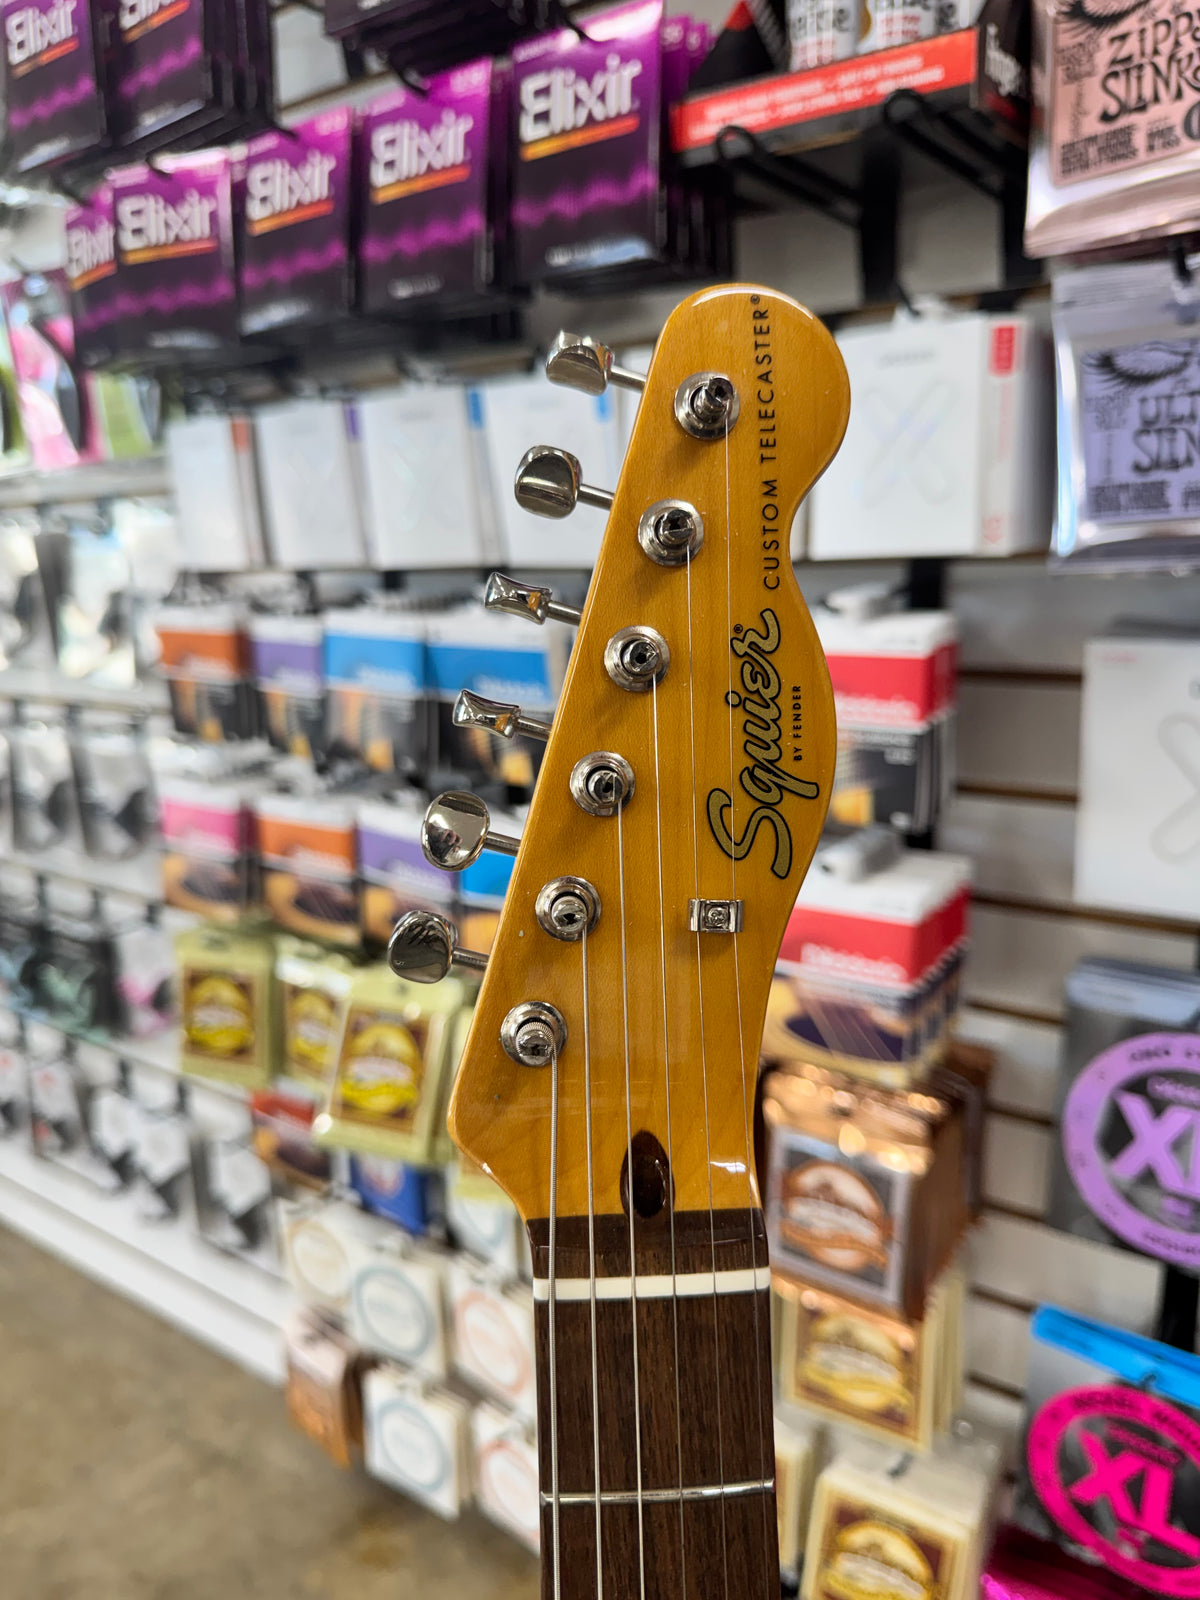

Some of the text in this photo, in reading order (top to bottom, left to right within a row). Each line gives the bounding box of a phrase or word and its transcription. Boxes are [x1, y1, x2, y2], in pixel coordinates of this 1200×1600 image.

[6, 0, 77, 66] Elixir
[520, 54, 643, 143] Elixir
[247, 149, 336, 222] Elixir
[370, 109, 474, 188] Elixir
[118, 189, 216, 251] Elixir
[762, 478, 780, 590] CUSTOM
[792, 685, 802, 762] BY FENDER
[1069, 1427, 1200, 1561] XL
